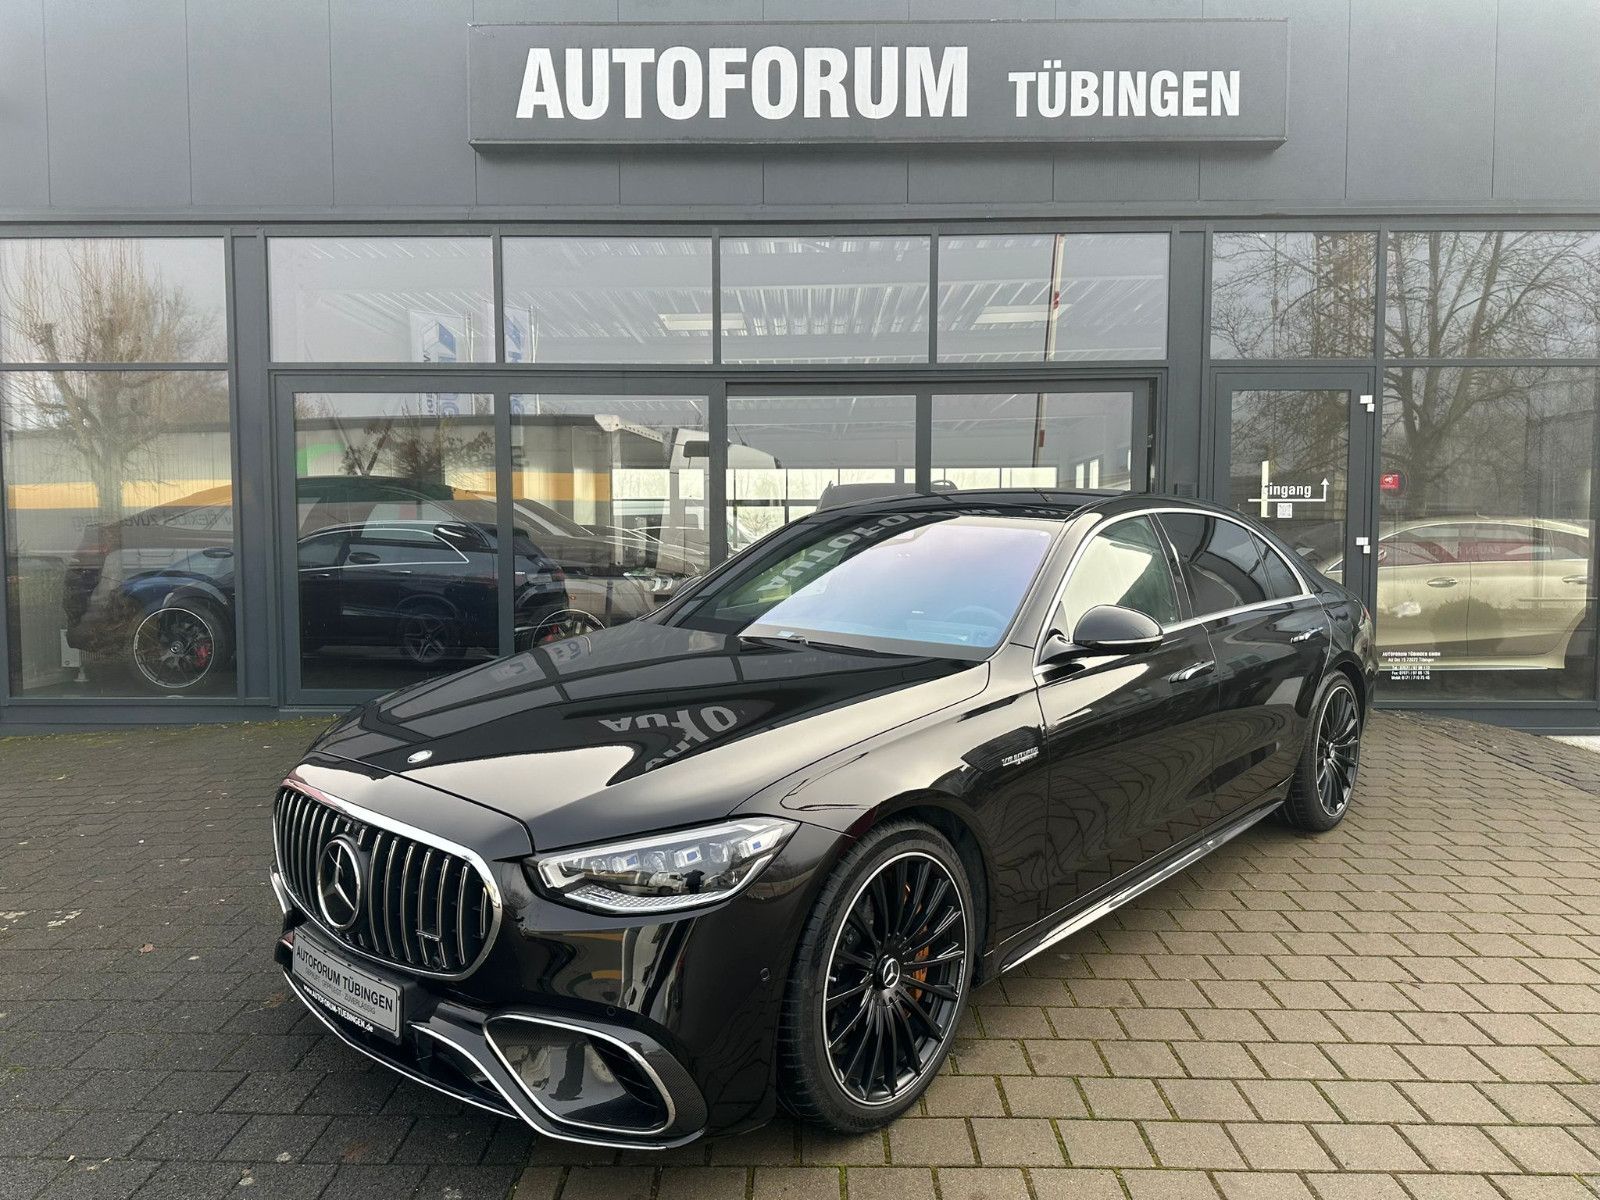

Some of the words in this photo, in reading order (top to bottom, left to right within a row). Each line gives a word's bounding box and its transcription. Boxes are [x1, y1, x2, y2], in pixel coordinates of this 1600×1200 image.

[516, 45, 968, 120] AUTOFORUM
[1008, 59, 1241, 118] TÜBINGEN
[296, 945, 341, 986] AUTOFORUM
[342, 975, 394, 1013] TÜBINGEN
